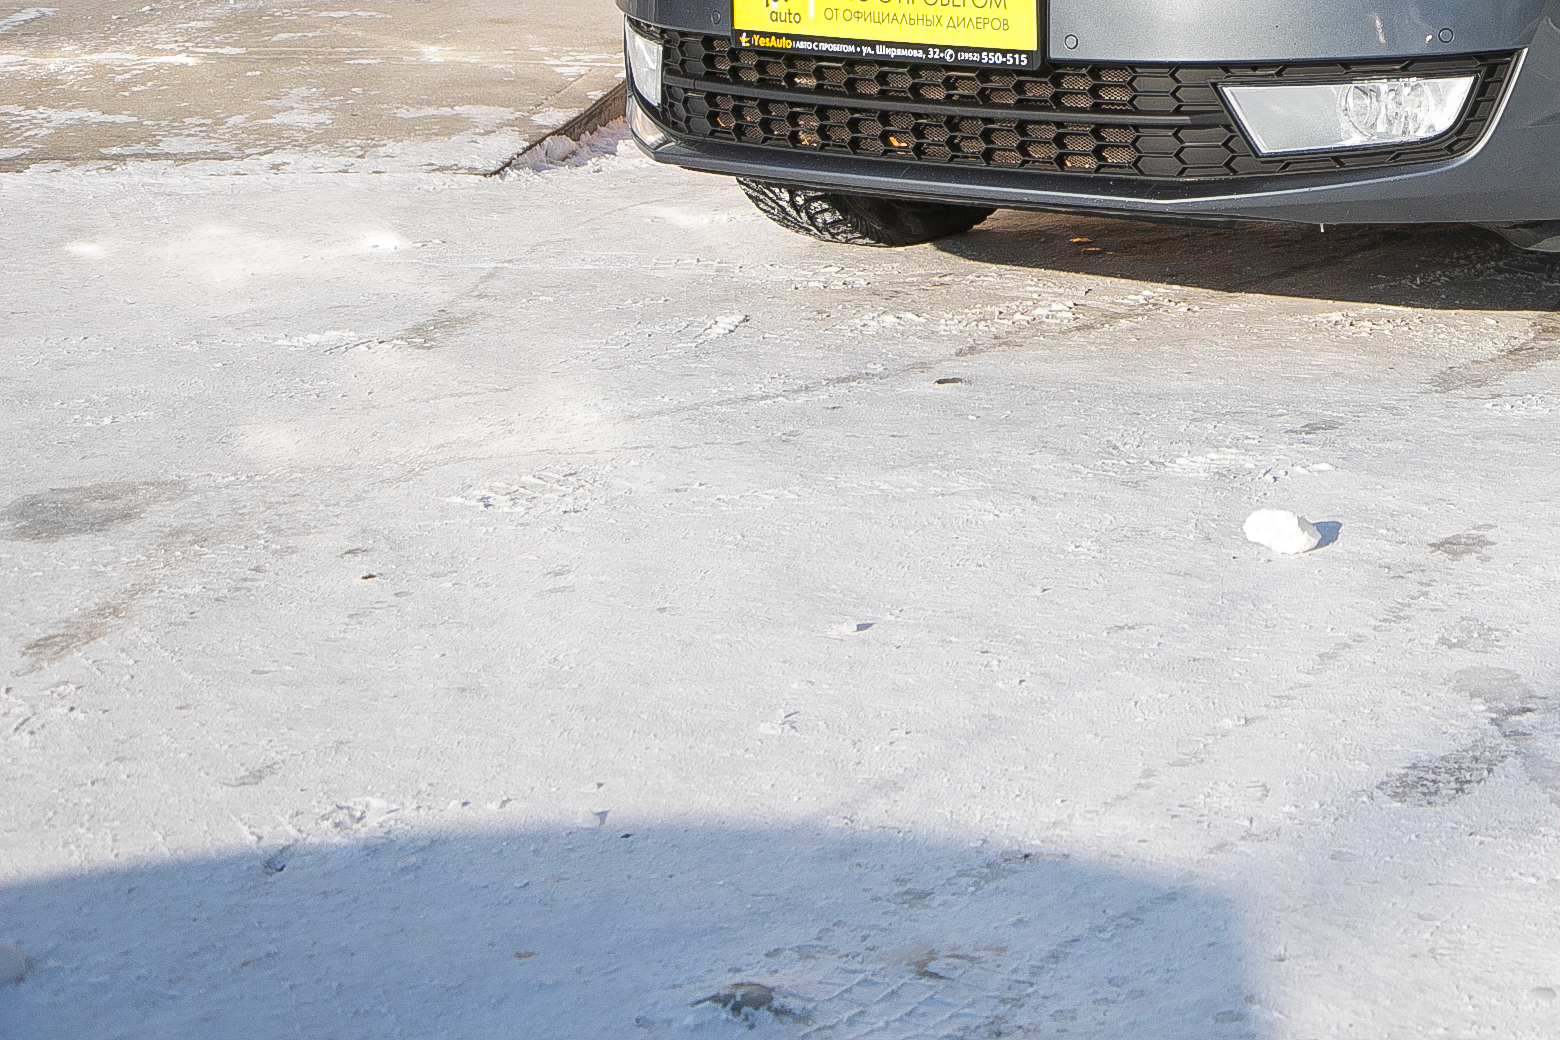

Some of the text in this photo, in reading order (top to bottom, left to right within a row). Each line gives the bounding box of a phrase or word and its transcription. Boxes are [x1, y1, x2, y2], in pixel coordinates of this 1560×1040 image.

[770, 9, 801, 24] auto
[824, 8, 1009, 31] ОТ ОФИЦИАЛЬНЫХ ДИЛЕРОВ
[755, 34, 793, 49] YesAuto
[819, 43, 855, 52] ПРОБЕГОМ
[876, 45, 926, 59] Ширямова,
[958, 52, 981, 62] (3952)
[982, 52, 1028, 66] 550-515
